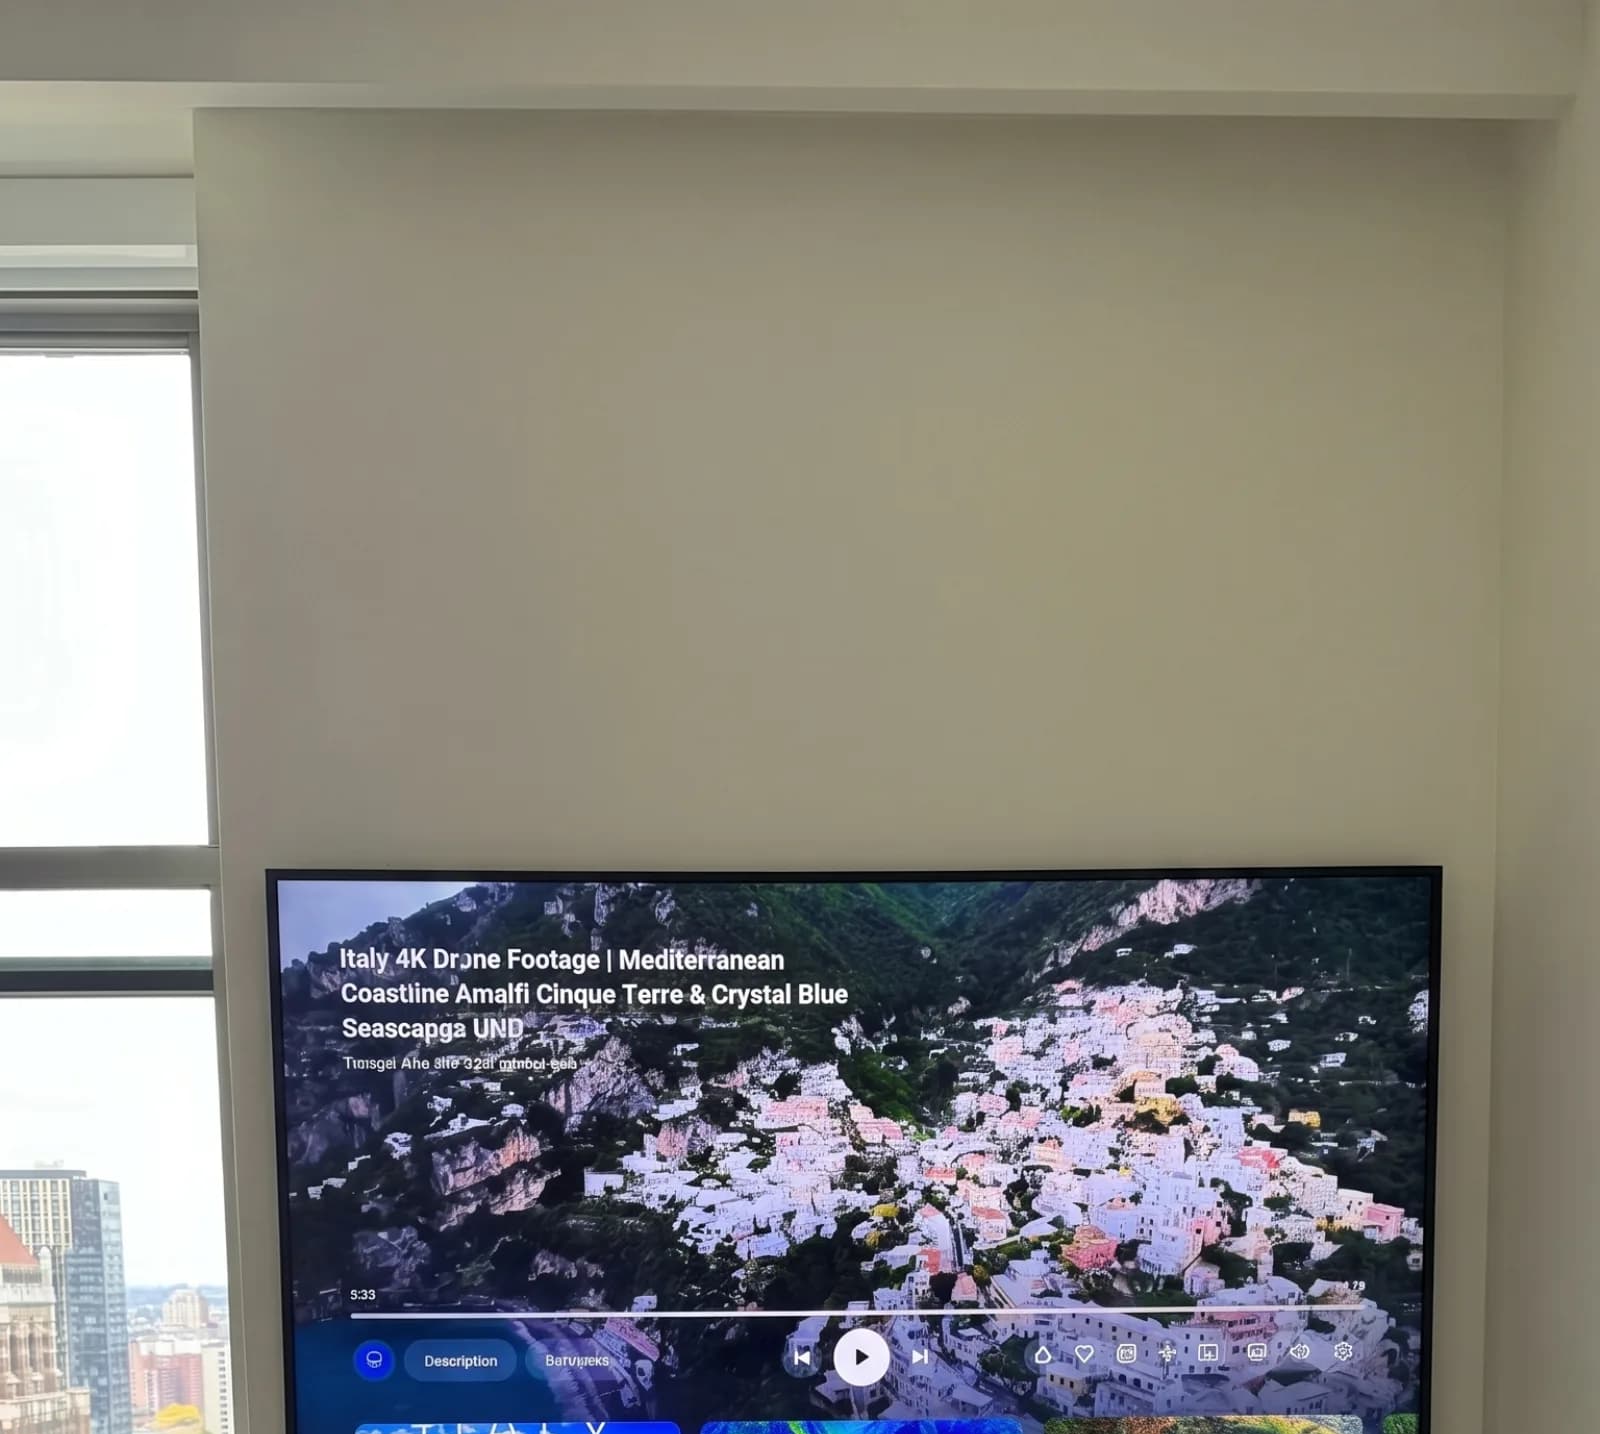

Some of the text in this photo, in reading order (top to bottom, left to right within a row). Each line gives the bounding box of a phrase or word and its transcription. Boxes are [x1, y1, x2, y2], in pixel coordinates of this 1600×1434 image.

[340, 947, 389, 975] Italy
[396, 948, 428, 969] 4K
[508, 948, 600, 974] Footage
[619, 949, 785, 970] Mediterranean
[341, 982, 849, 1010] Coastline Amalfi Cinque Terre & Crystal Blue
[473, 1018, 524, 1039] UND
[424, 1355, 498, 1370] Description
